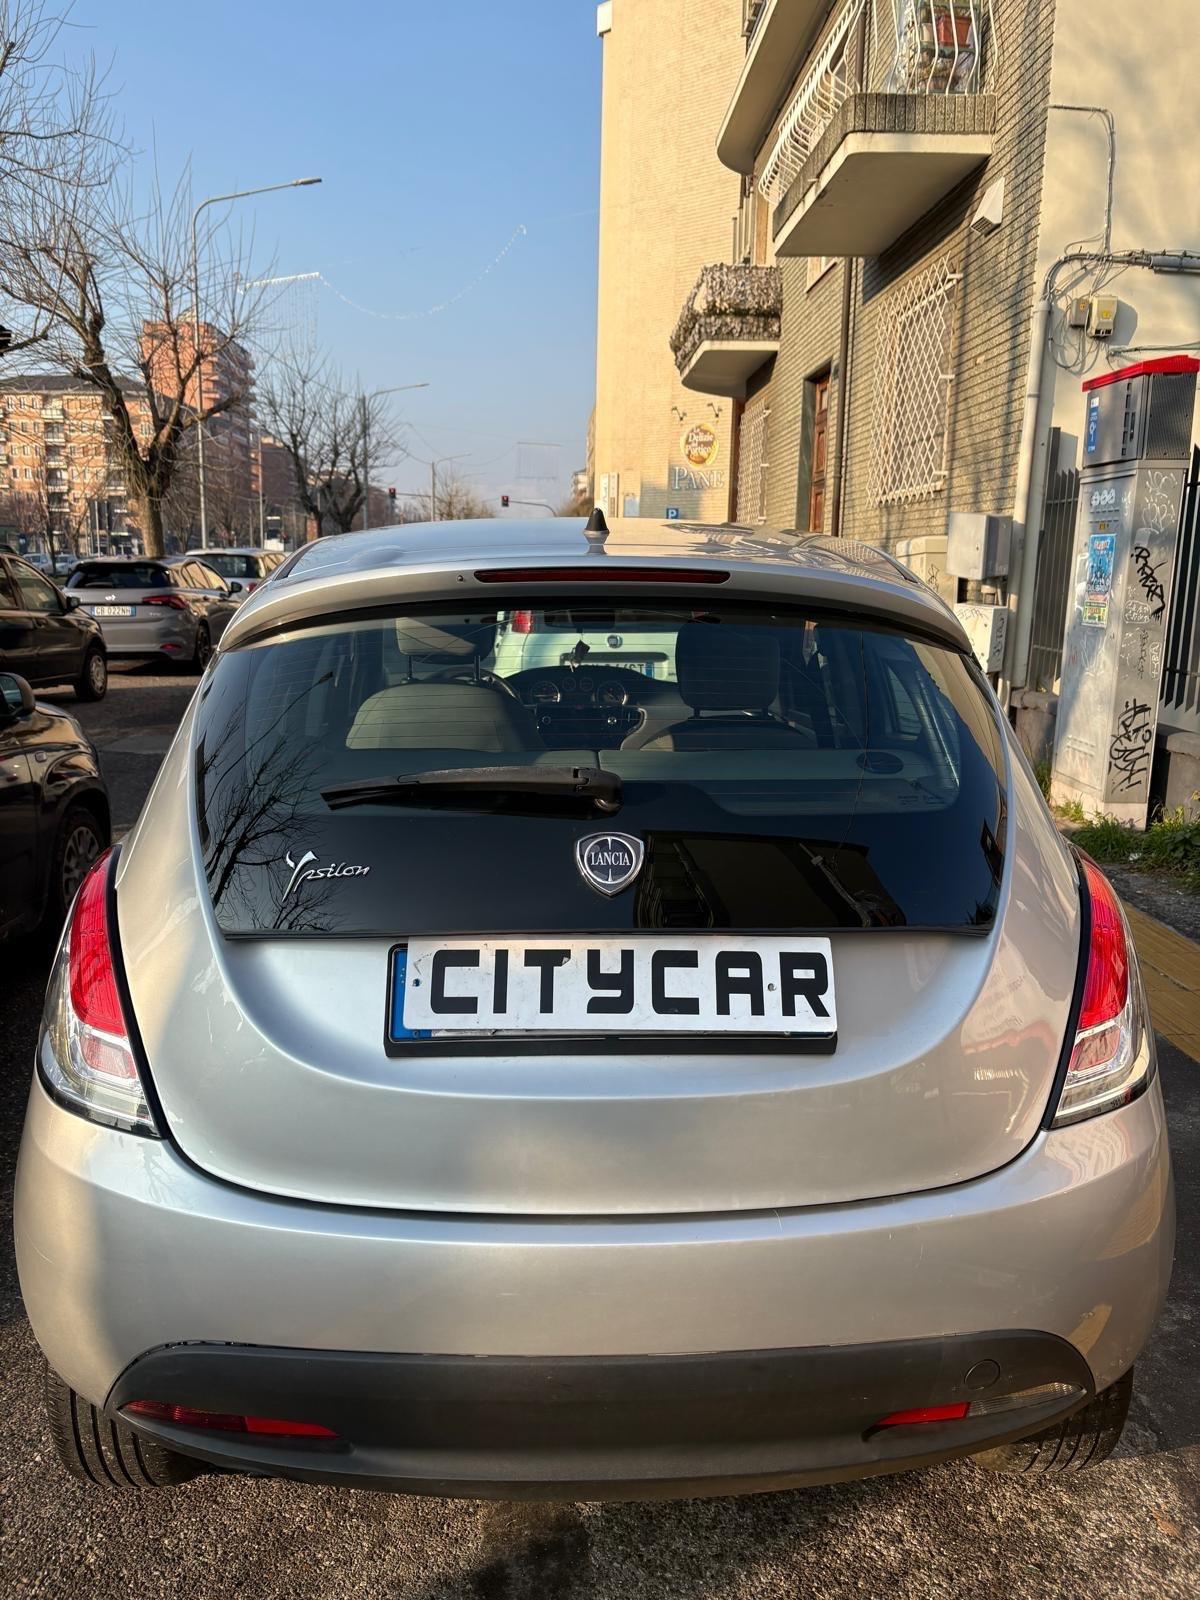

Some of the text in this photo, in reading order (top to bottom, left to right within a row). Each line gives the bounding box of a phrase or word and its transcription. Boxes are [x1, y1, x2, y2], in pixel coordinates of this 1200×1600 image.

[688, 431, 714, 442] Delizie
[685, 443, 712, 454] Portico
[672, 466, 725, 490] PANE
[590, 851, 632, 866] LANCIA
[281, 850, 370, 902] Ypsilon
[430, 949, 831, 1018] CITYCAR
